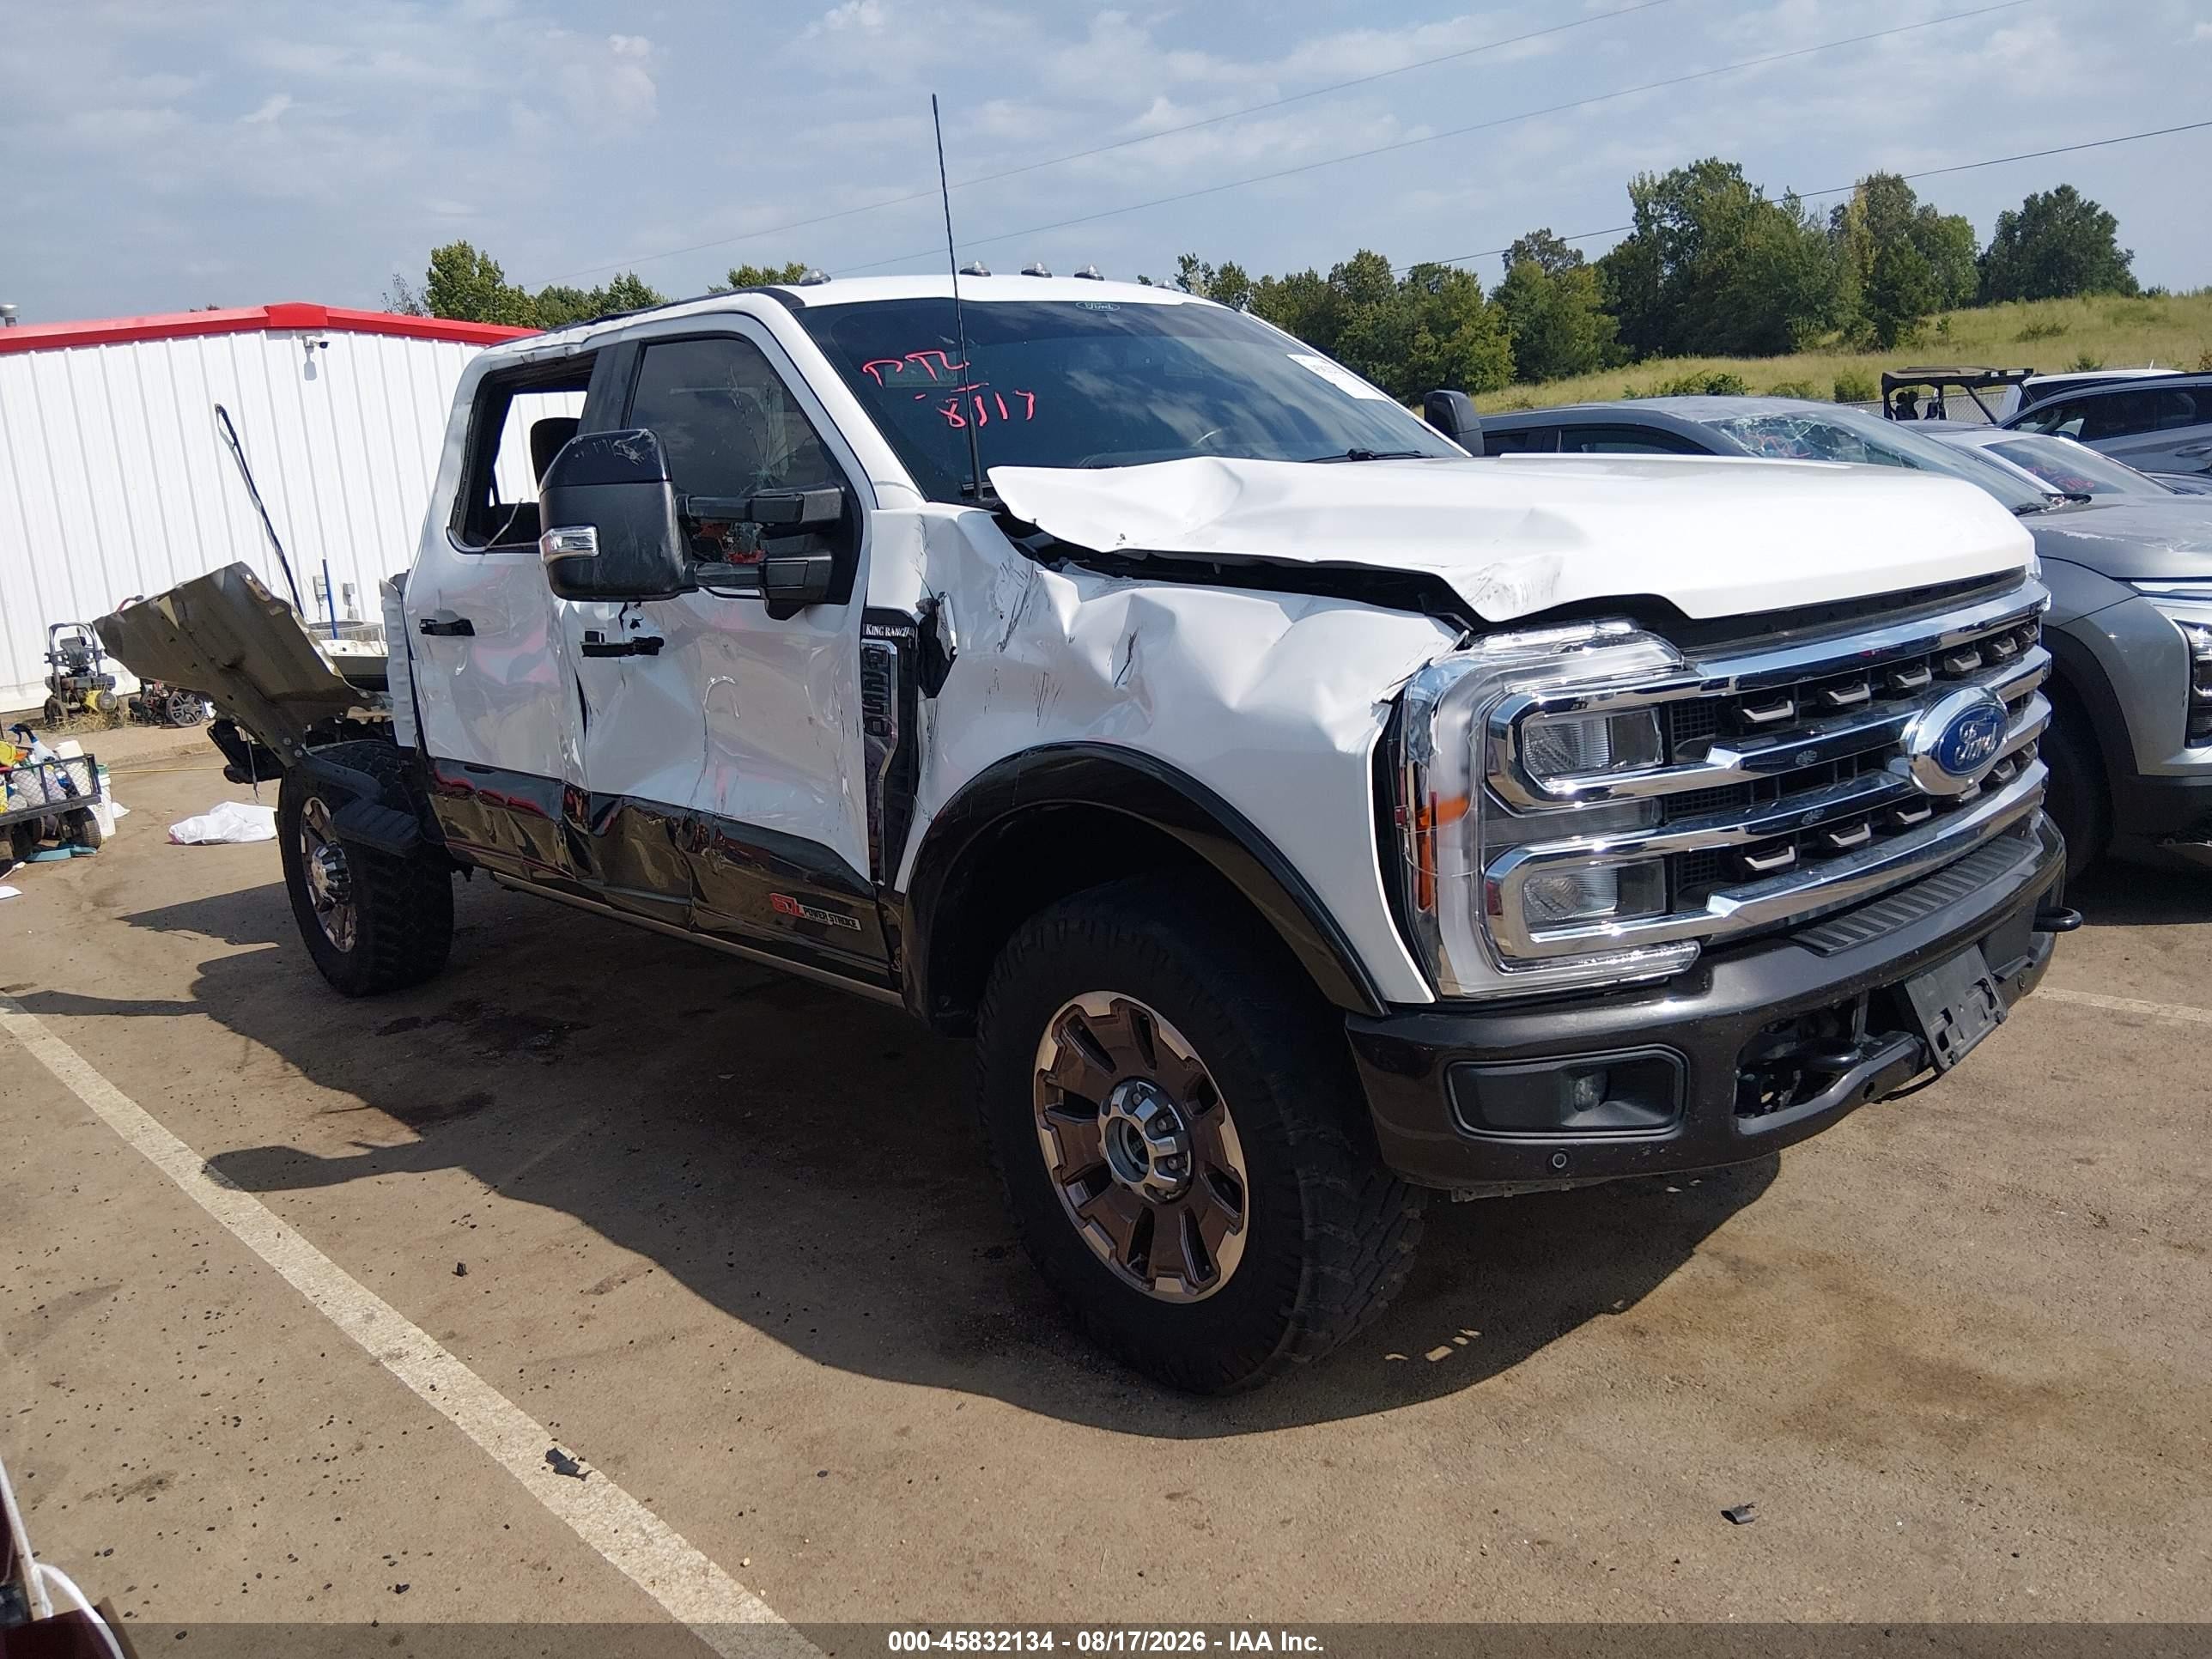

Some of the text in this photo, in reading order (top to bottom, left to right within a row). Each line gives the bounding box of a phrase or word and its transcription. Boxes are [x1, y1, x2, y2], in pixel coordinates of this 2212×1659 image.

[866, 623, 910, 637] KING RANCH
[1954, 708, 1998, 766] Ford
